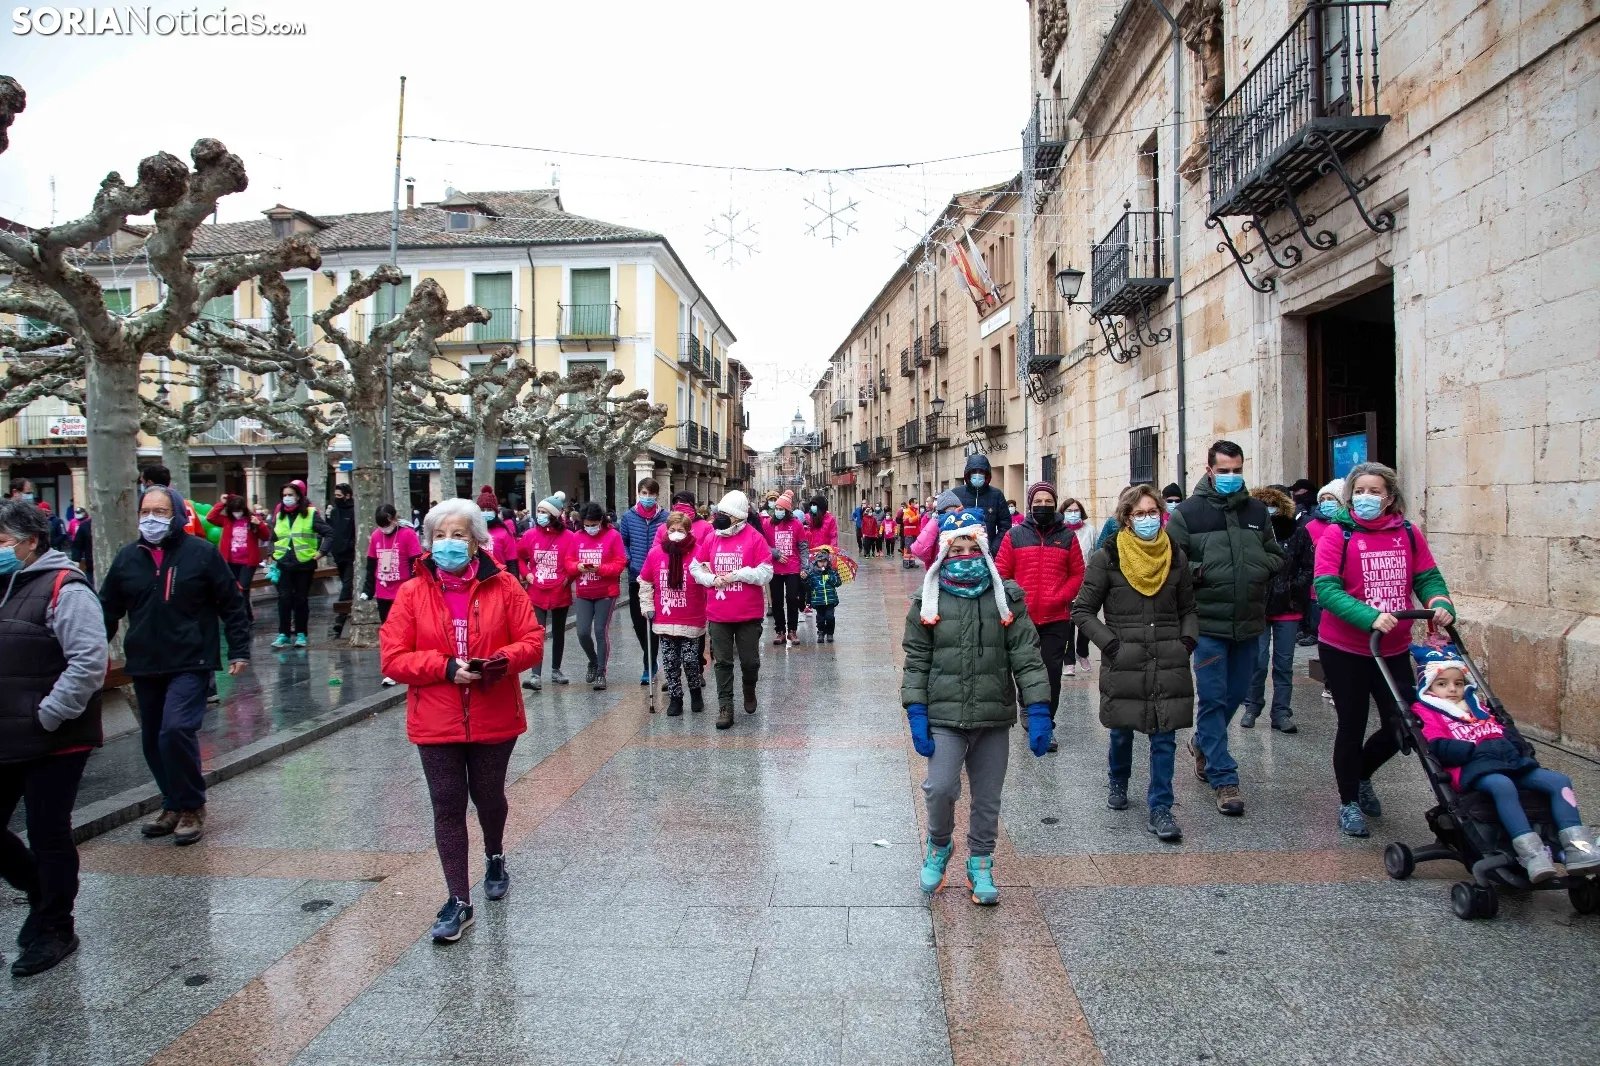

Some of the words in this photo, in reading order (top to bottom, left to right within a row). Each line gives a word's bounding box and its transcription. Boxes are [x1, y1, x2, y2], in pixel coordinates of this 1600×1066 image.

[719, 556, 743, 565] MARCHA
[1370, 556, 1407, 571] MARCHA
[1363, 568, 1407, 582] SOLIDARIA
[1364, 586, 1398, 599] CONTRA
[1399, 585, 1406, 596] EL
